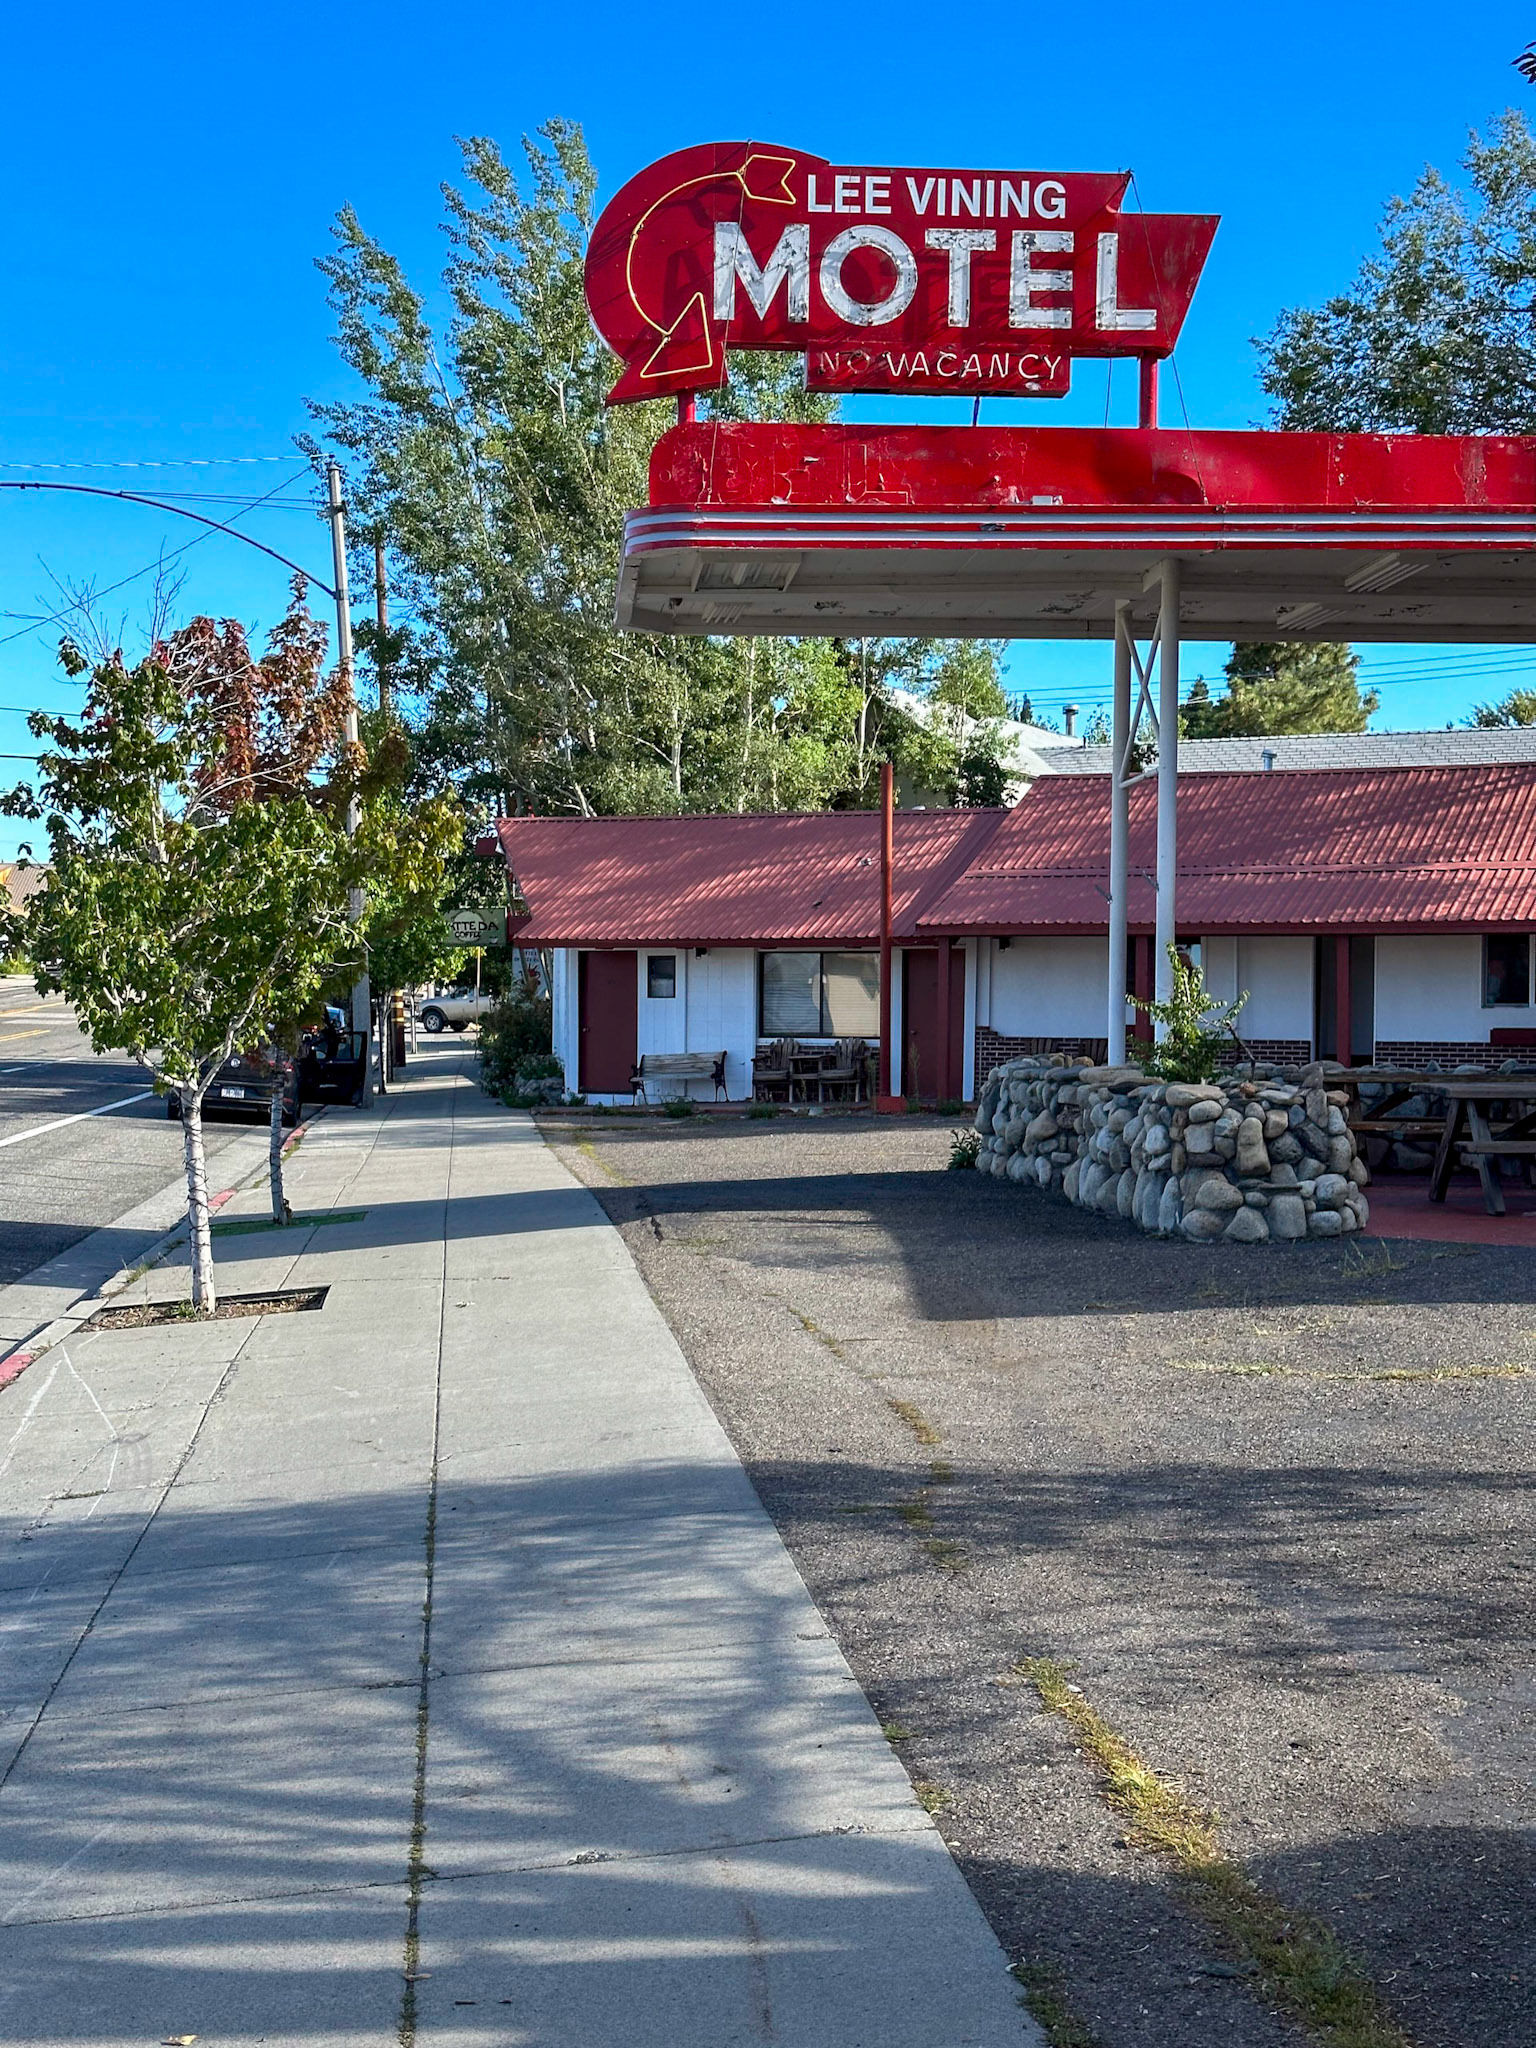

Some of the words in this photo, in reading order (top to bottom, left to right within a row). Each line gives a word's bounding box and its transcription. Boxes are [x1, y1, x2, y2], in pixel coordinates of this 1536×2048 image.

[807, 173, 892, 215] LEE
[905, 176, 1067, 219] VINING
[713, 221, 1158, 331] MOTEL
[818, 351, 871, 375] NO
[882, 351, 1062, 380] VACANCY
